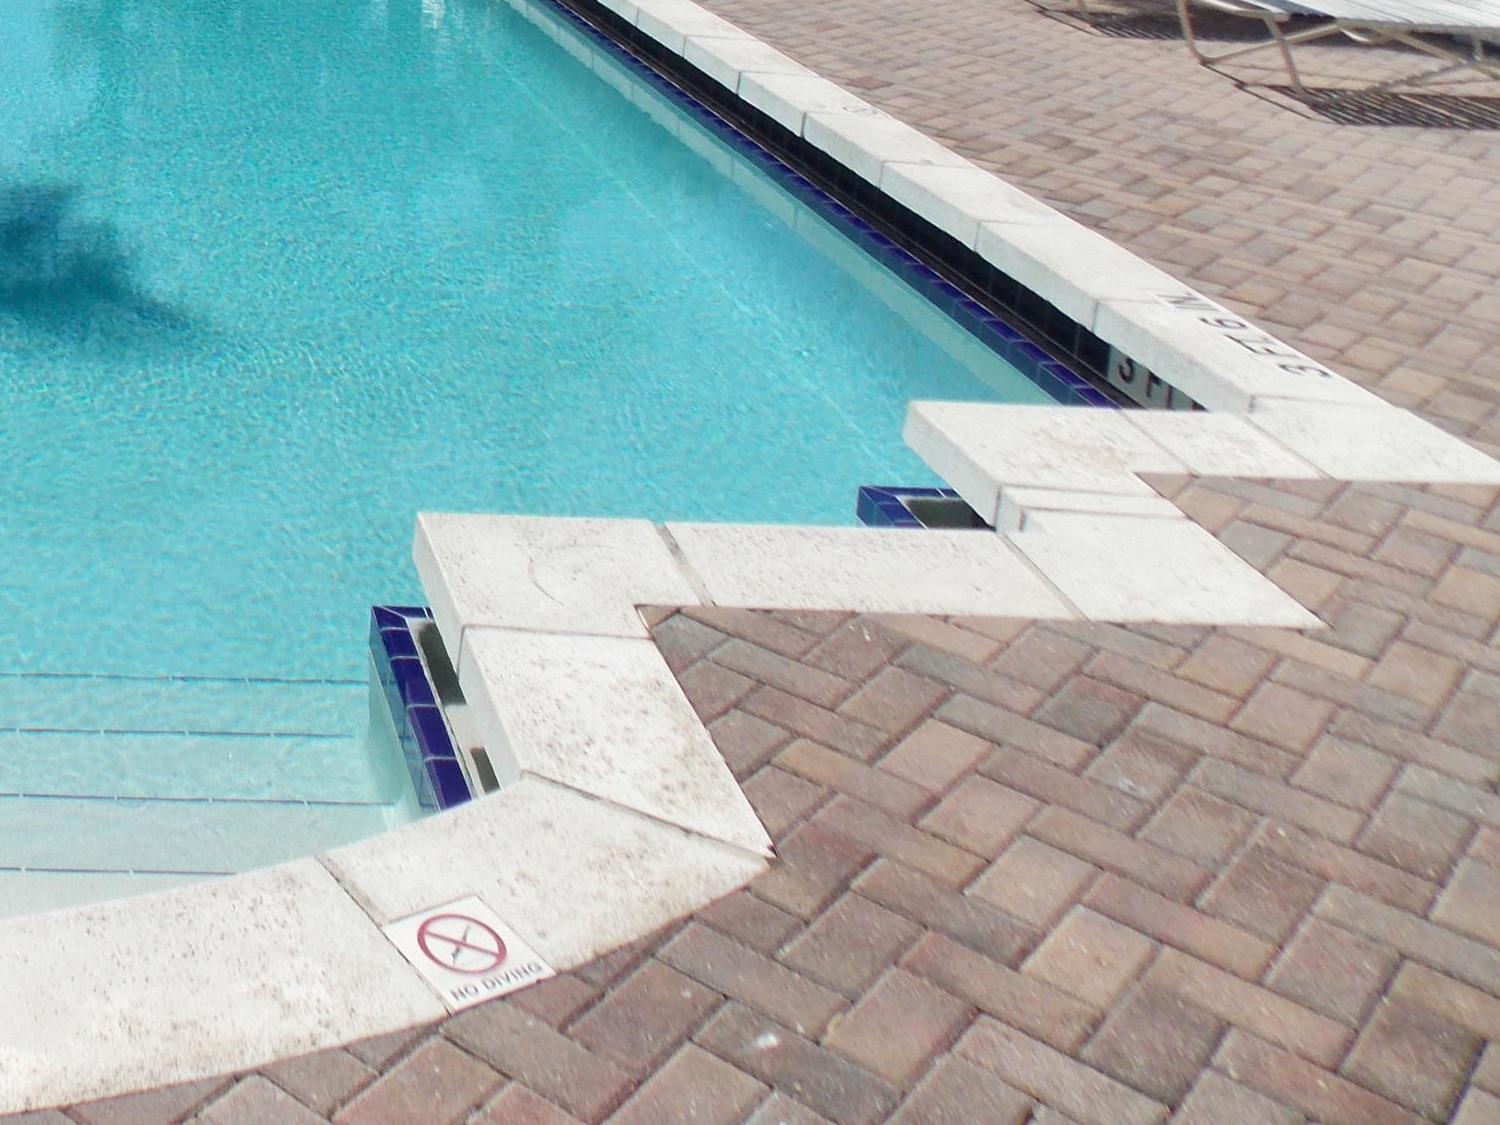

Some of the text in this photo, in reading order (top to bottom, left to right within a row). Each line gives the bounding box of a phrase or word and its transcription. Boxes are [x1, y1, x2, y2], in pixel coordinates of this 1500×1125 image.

[1198, 316, 1250, 331] 6
[1222, 333, 1303, 360] FT
[1277, 361, 1332, 378] 3
[449, 961, 543, 1003] NO DIVING
